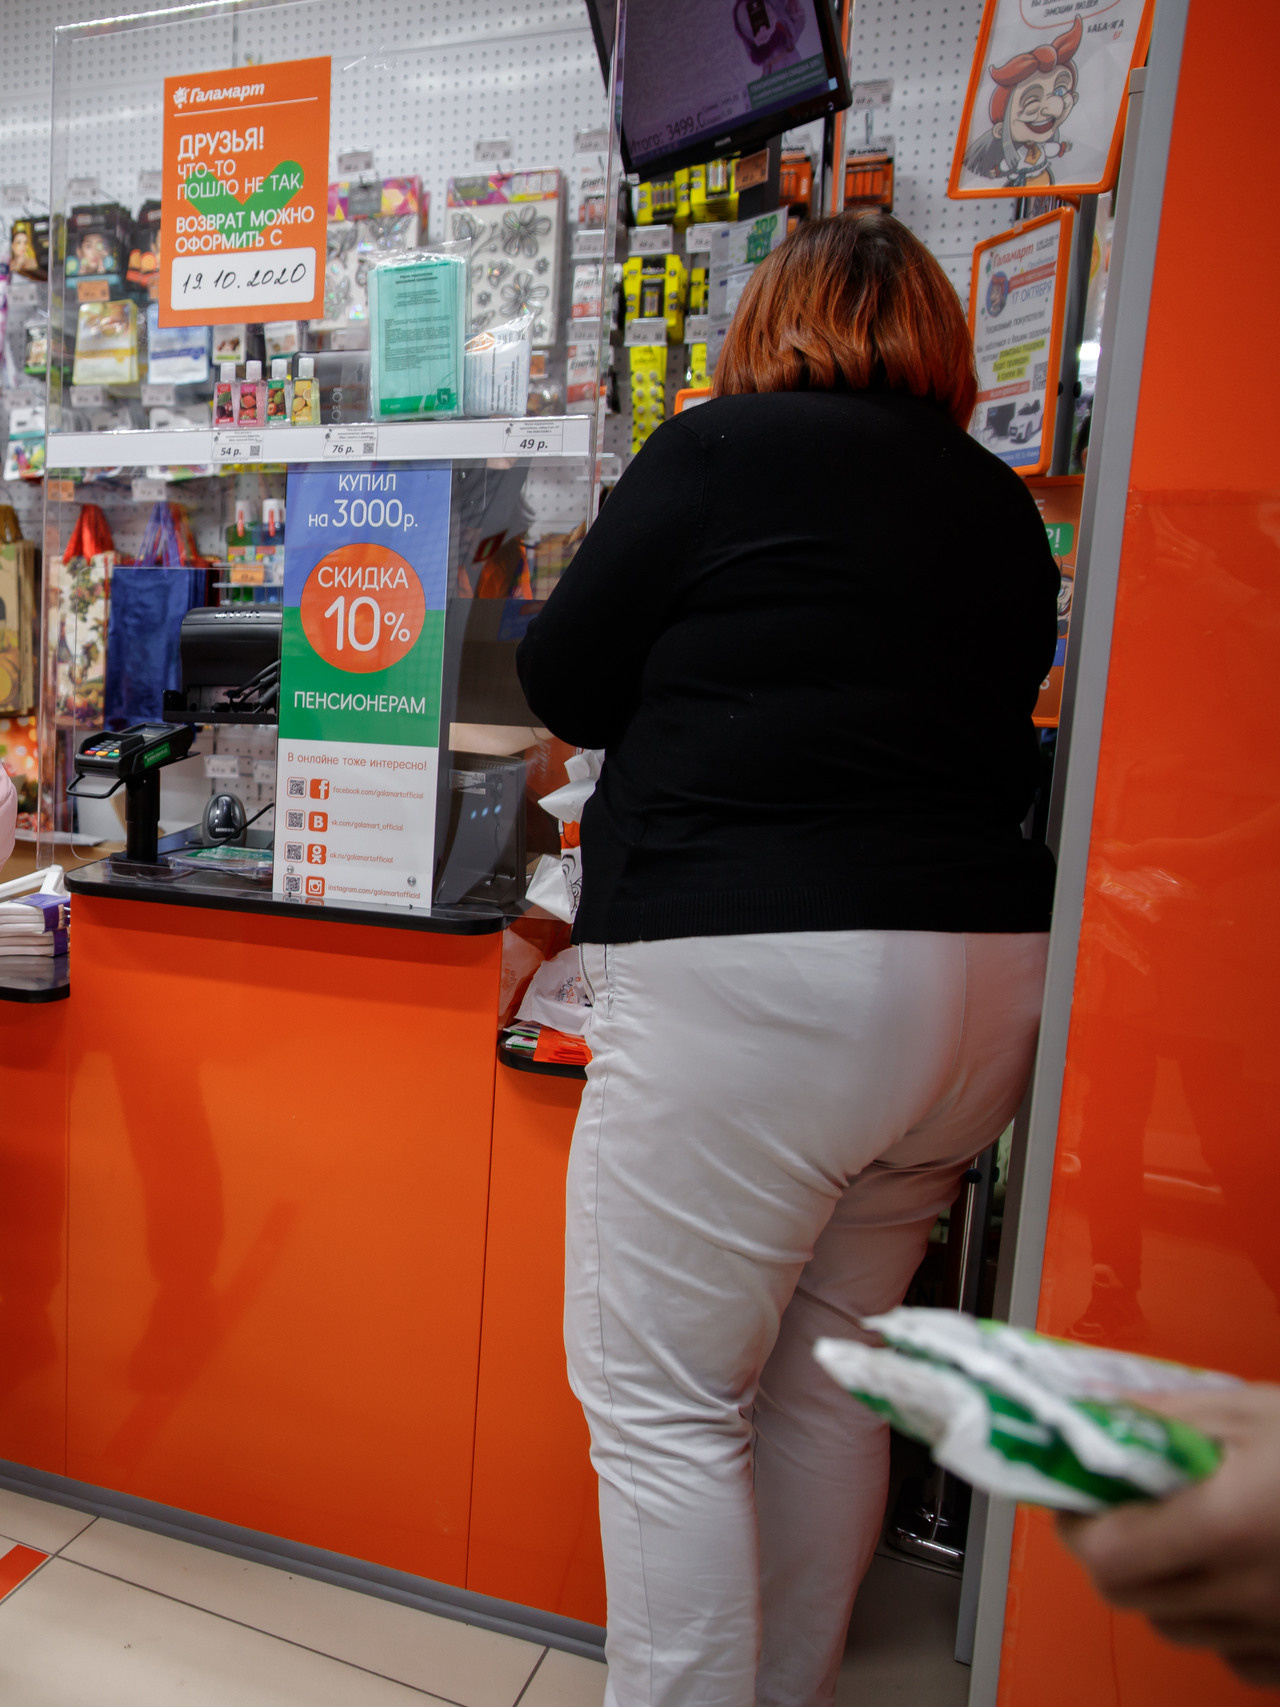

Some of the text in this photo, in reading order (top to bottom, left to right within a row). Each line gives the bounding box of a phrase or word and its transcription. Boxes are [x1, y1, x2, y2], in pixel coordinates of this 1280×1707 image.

[190, 83, 265, 103] Галамарт
[178, 126, 264, 161] ДРУЗЬЯ!
[178, 159, 236, 180] ЧТО-ТО
[177, 173, 304, 200] ПОШЛО НЕ ТАК.
[176, 205, 315, 234] ВОЗВРАТ МОЖНО
[175, 229, 282, 253] ОФОРМИТЬ С
[220, 447, 232, 456] 54
[332, 445, 344, 454] 76
[520, 439, 548, 451] 49 р.
[338, 473, 397, 492] КУПИЛ
[308, 513, 329, 528] на
[318, 566, 409, 591] СКИДКА
[324, 595, 411, 652] 10%
[294, 691, 426, 715] ПЕНСИОНЕРАМ
[287, 752, 428, 771] В онлайне тоже интересно!
